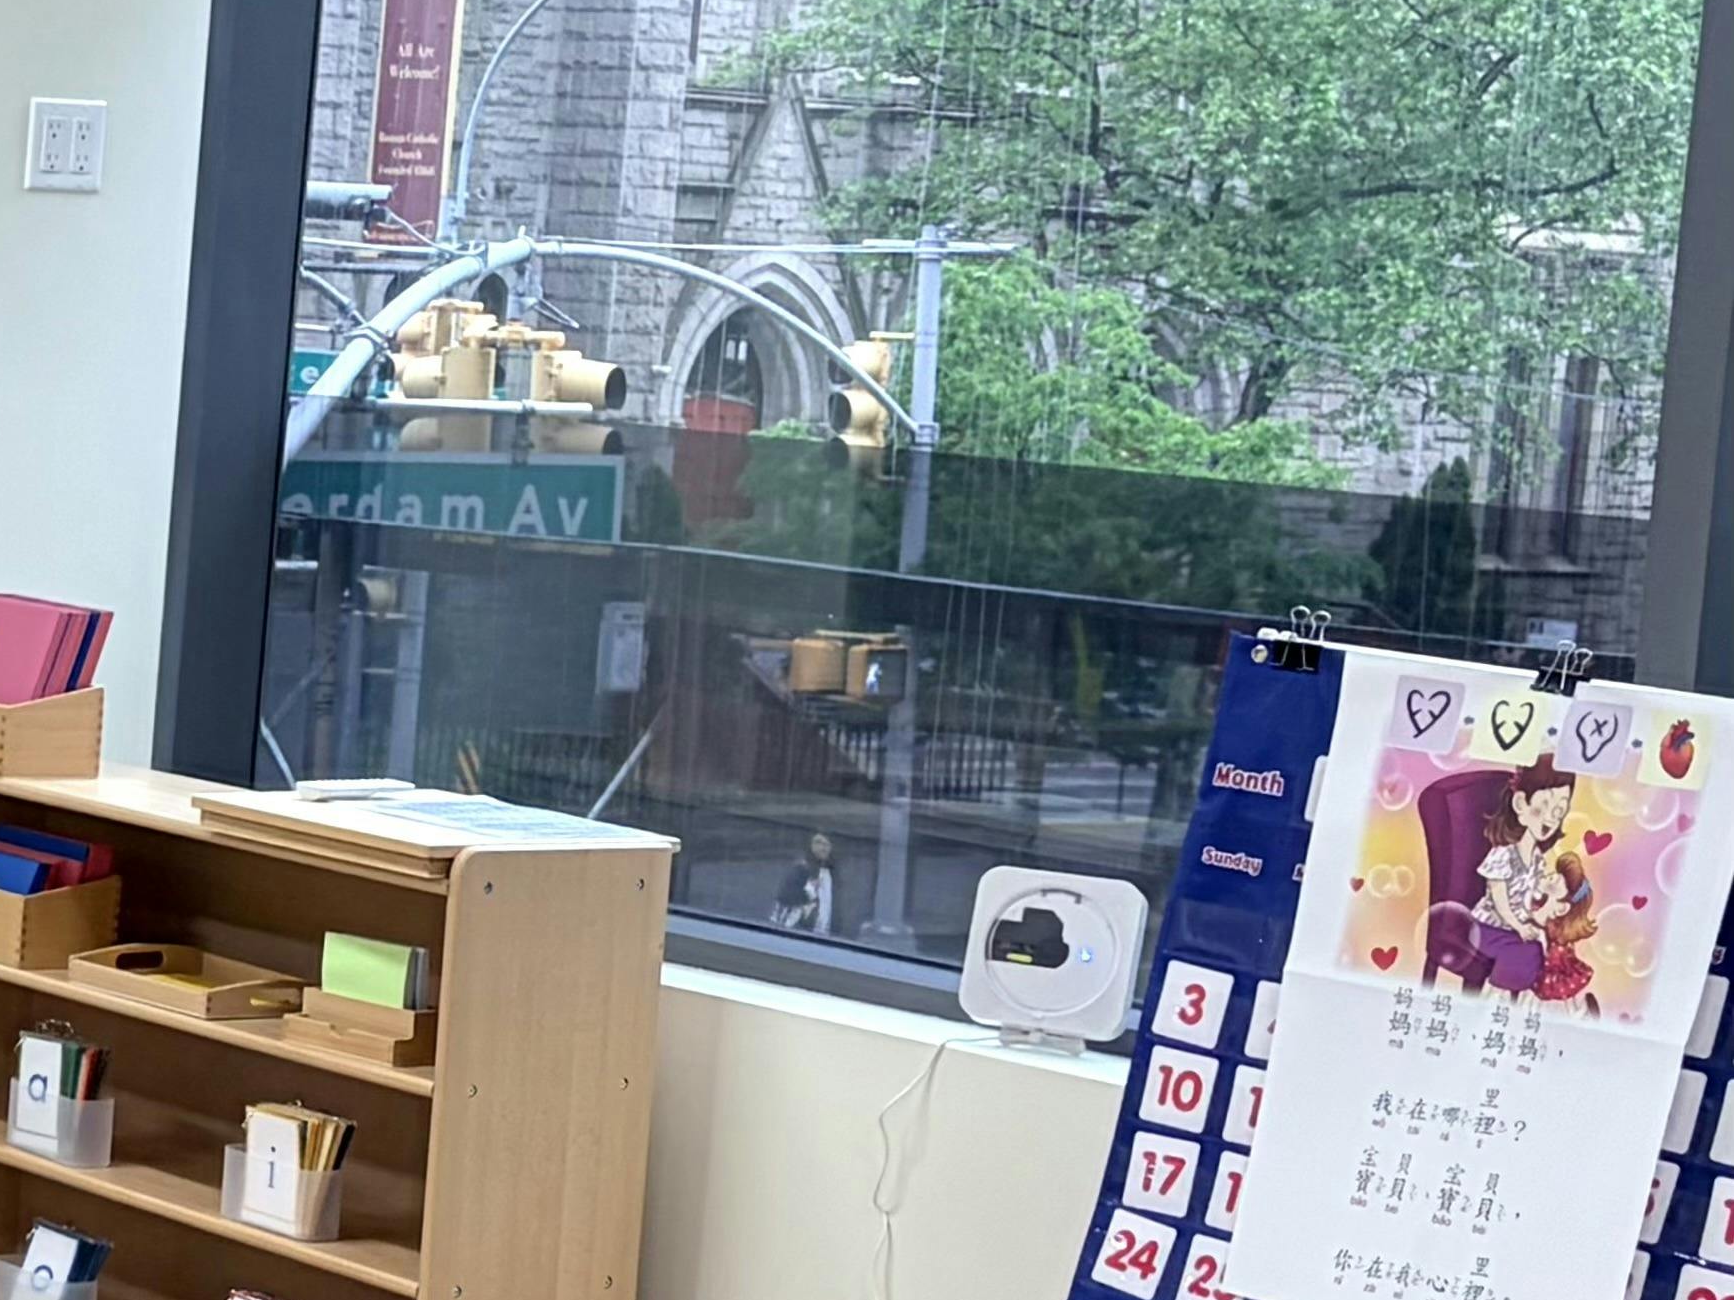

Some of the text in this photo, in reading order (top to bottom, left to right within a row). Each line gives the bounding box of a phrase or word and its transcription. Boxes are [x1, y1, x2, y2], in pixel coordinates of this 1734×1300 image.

[507, 483, 589, 537] Av
[1213, 762, 1284, 797] Month
[1202, 846, 1263, 877] Sunday
[1177, 983, 1206, 1025] 3
[27, 1073, 49, 1103] a
[1157, 1064, 1203, 1112] 10
[266, 1145, 278, 1190] i
[1142, 1150, 1186, 1196] 17
[1104, 1229, 1160, 1281] 24
[32, 1264, 54, 1292] o
